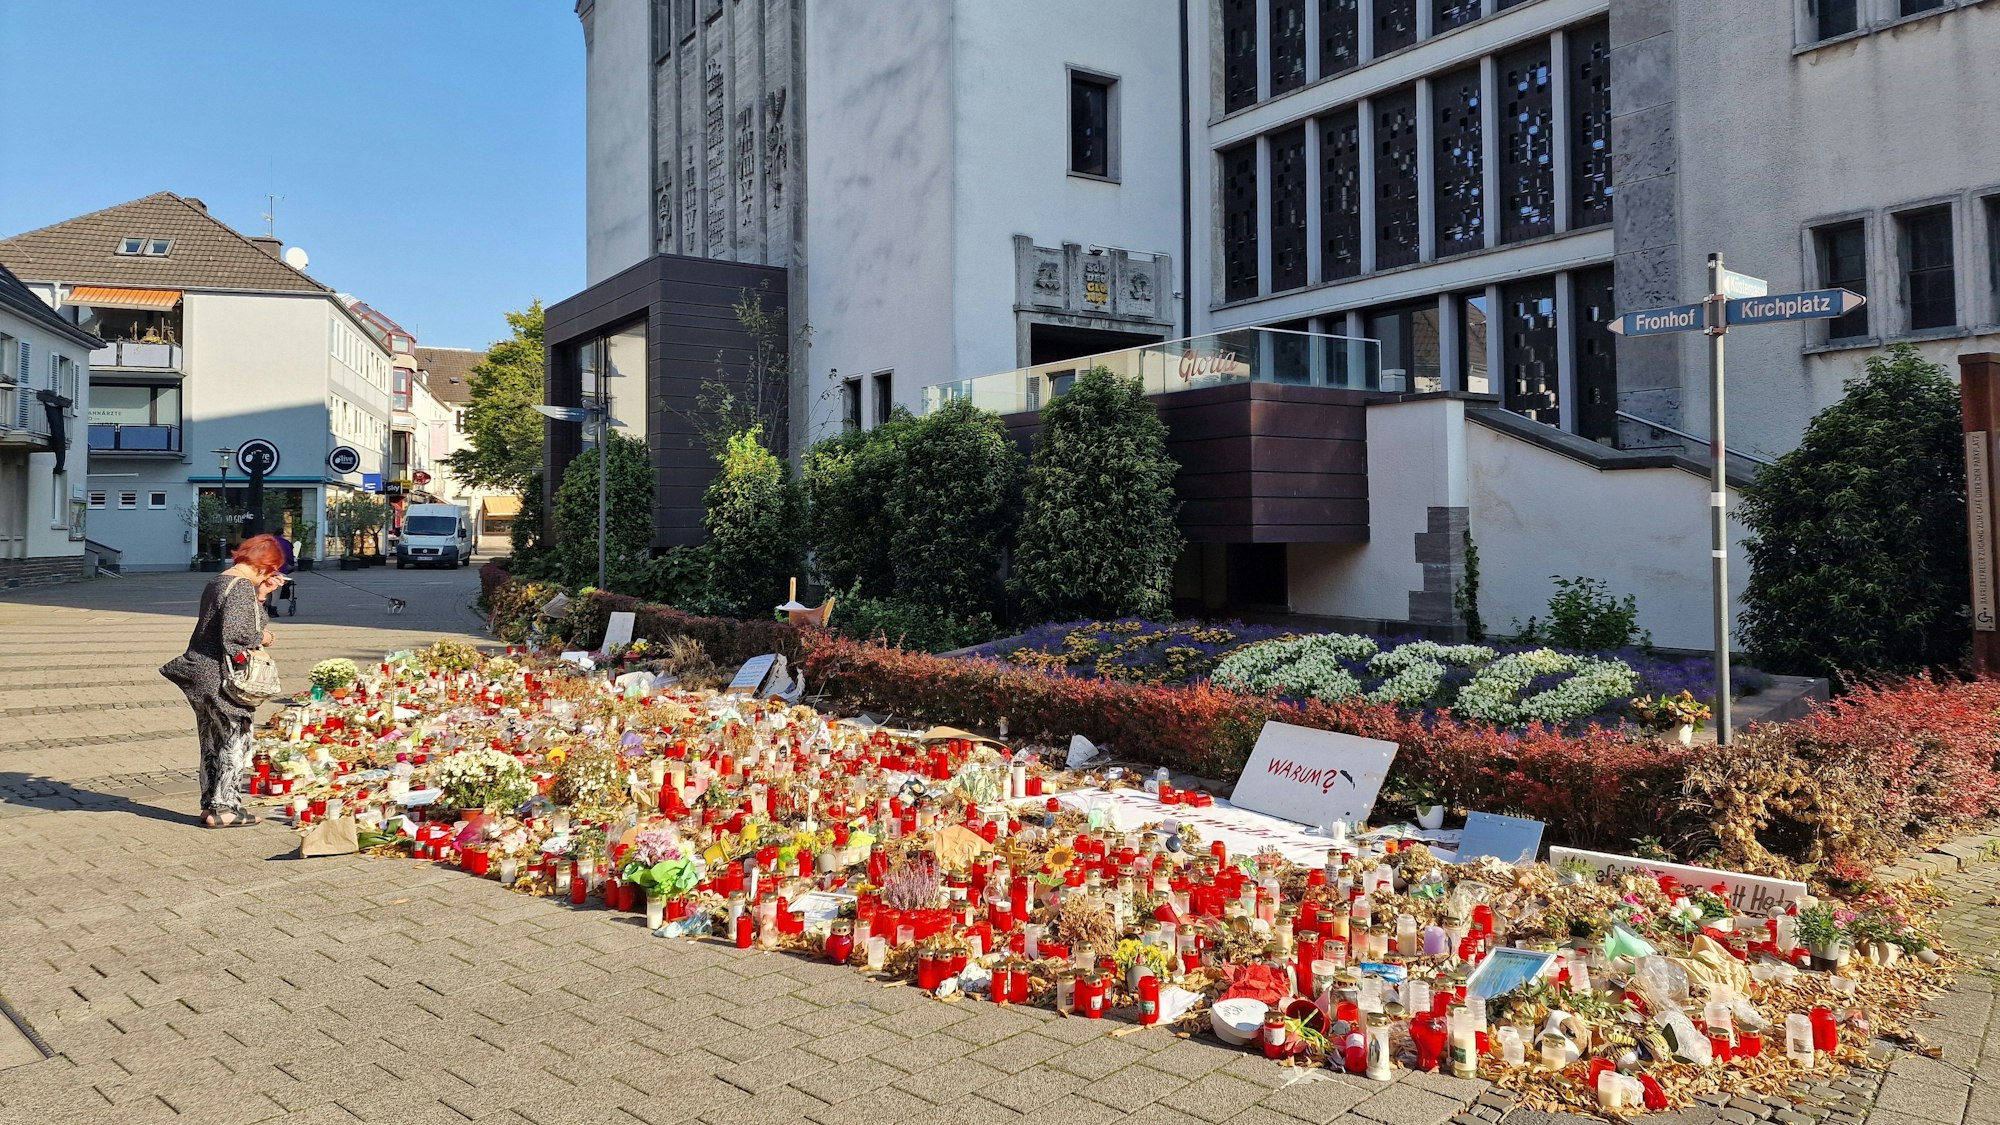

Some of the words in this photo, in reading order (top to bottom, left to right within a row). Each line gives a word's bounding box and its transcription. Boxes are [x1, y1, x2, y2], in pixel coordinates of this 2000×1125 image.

[1086, 273, 1107, 284] DEO
[1741, 295, 1831, 318] Kirchplatz
[1635, 309, 1695, 331] Fronhof
[1179, 348, 1238, 382] Gloria
[387, 484, 400, 492] sky
[1267, 757, 1338, 794] WARUM?
